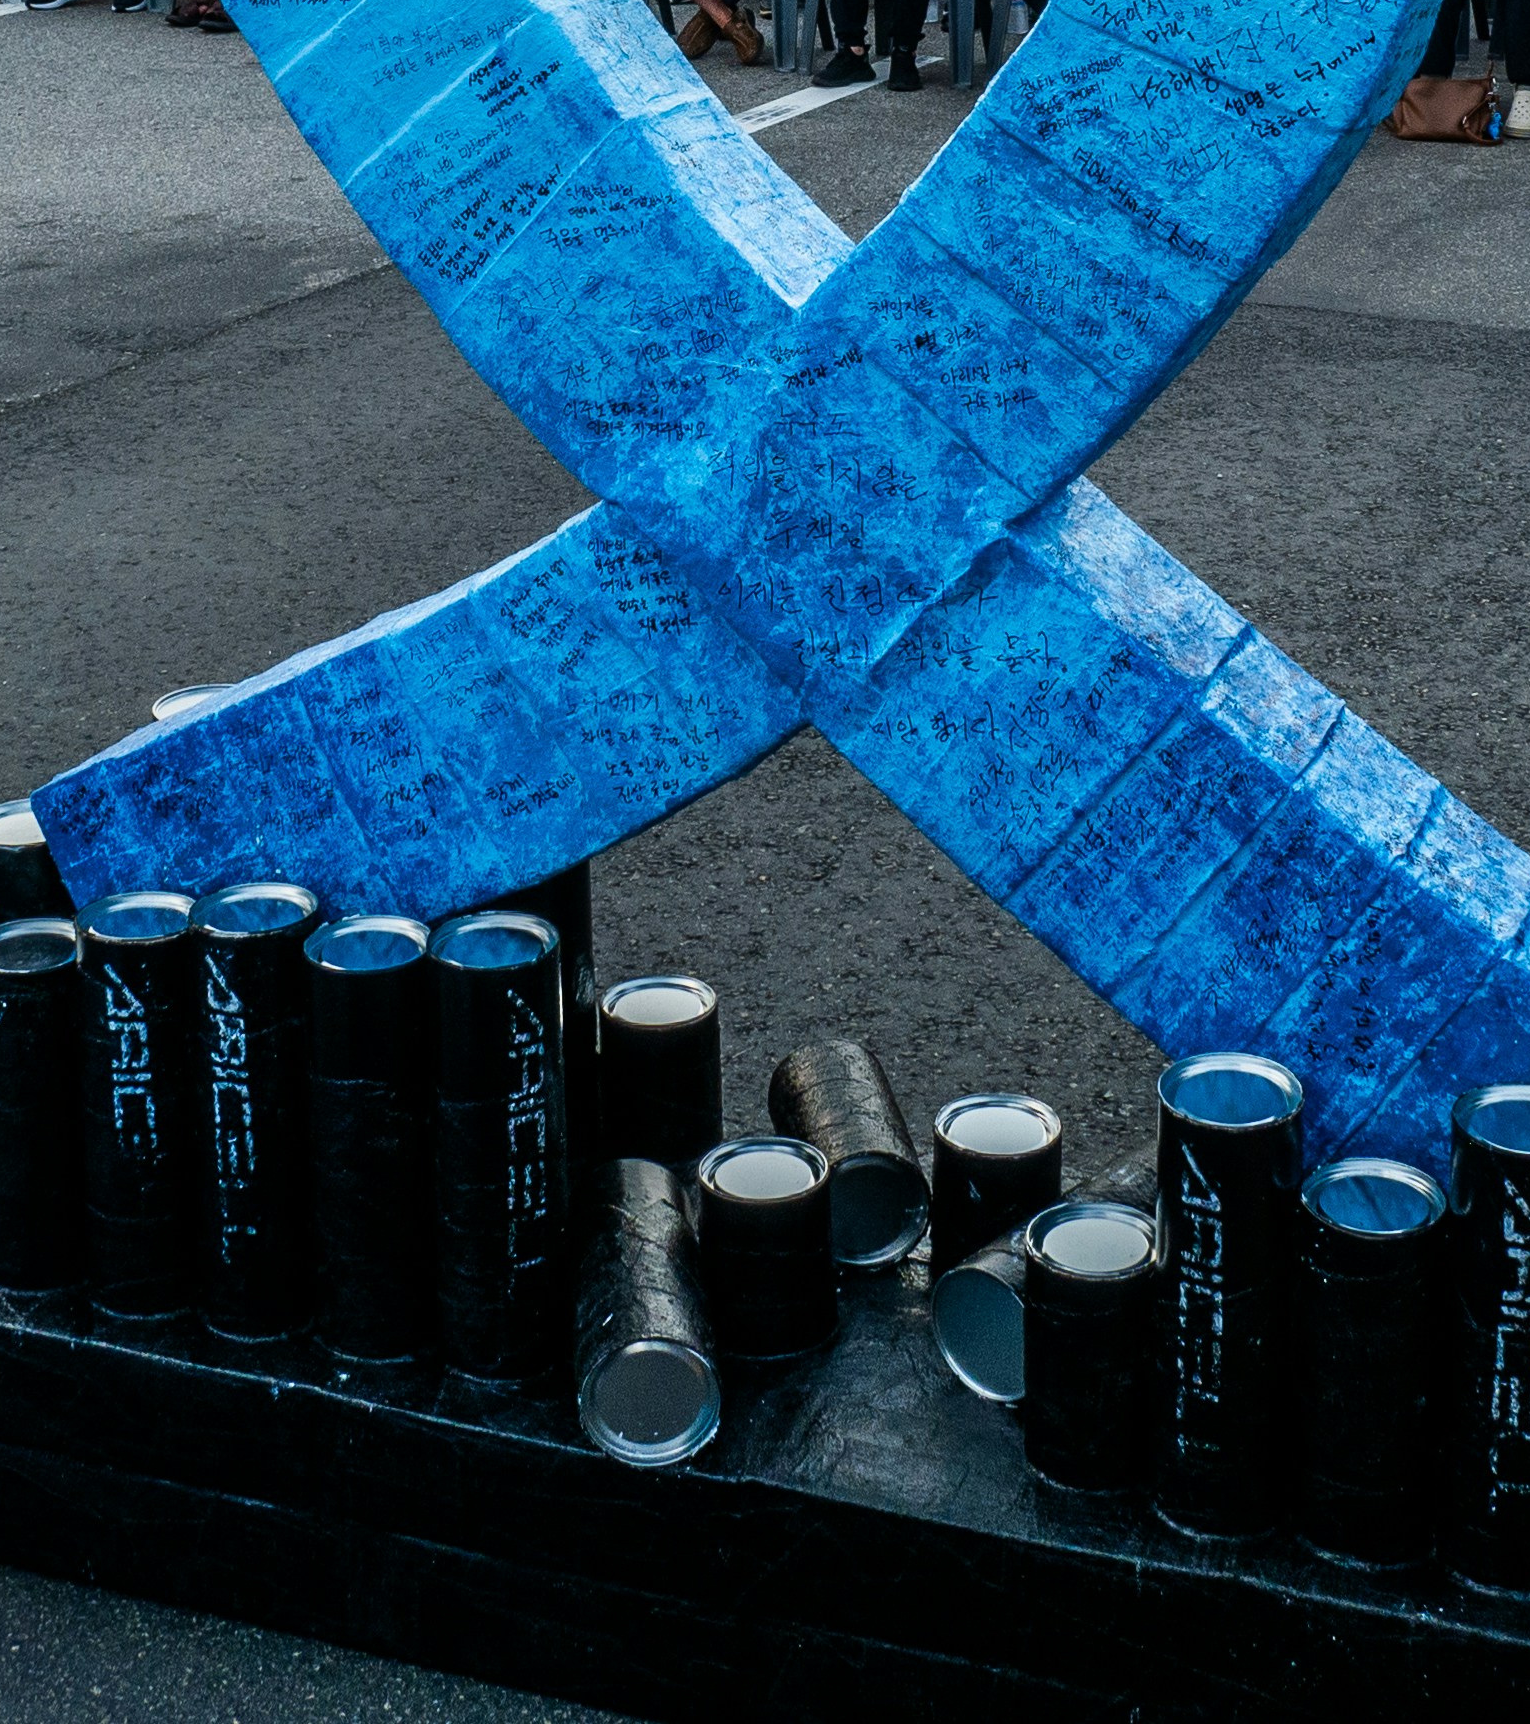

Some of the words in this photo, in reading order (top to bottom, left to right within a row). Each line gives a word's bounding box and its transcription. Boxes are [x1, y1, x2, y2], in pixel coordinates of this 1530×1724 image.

[1224, 83, 1287, 119] 생명은
[539, 225, 587, 255] 죽음을
[812, 455, 863, 495] 지지
[763, 508, 866, 552] 무책임
[717, 575, 803, 616] 이제는
[820, 574, 884, 617] 진정
